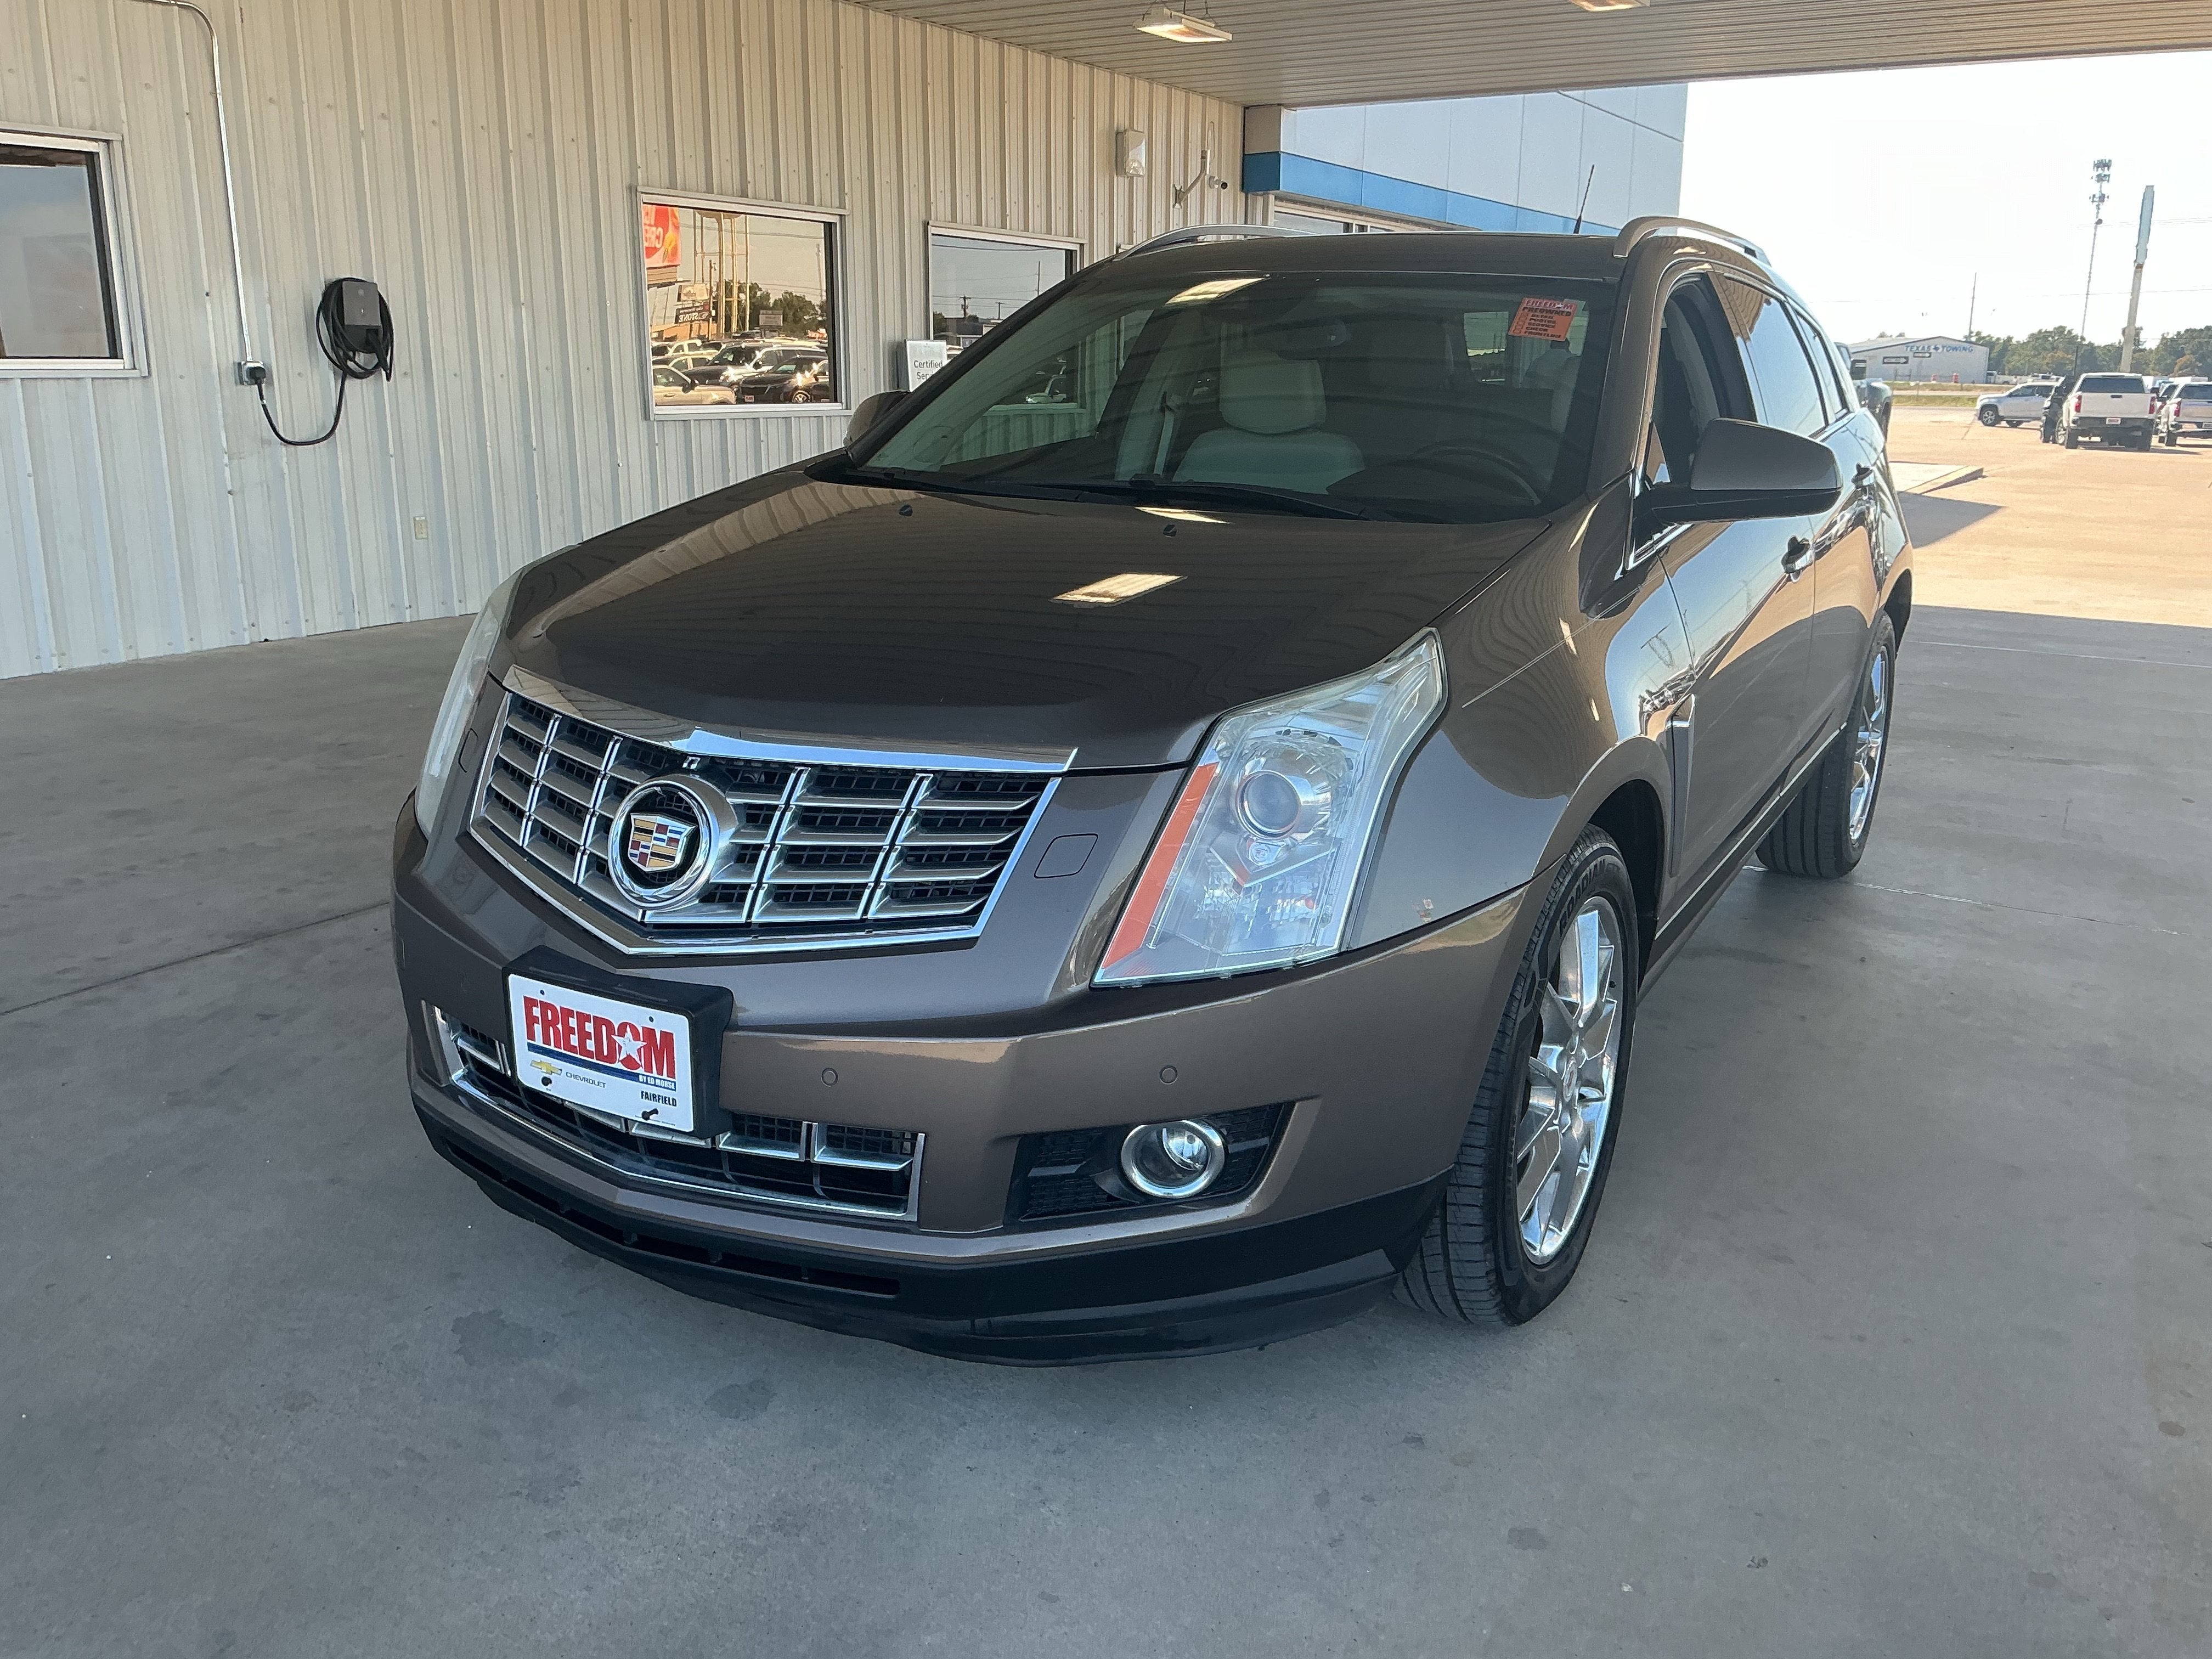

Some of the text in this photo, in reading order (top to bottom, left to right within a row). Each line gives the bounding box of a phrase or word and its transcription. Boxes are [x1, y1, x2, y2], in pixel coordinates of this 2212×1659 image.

[1522, 307, 1572, 316] PREOWNED
[913, 359, 943, 368] Certified
[523, 995, 676, 1079] FREEDOM
[566, 1071, 606, 1088] CHEVROLET
[639, 1074, 675, 1090] BY ED MORSE
[640, 1090, 677, 1107] FAIRFIELD
